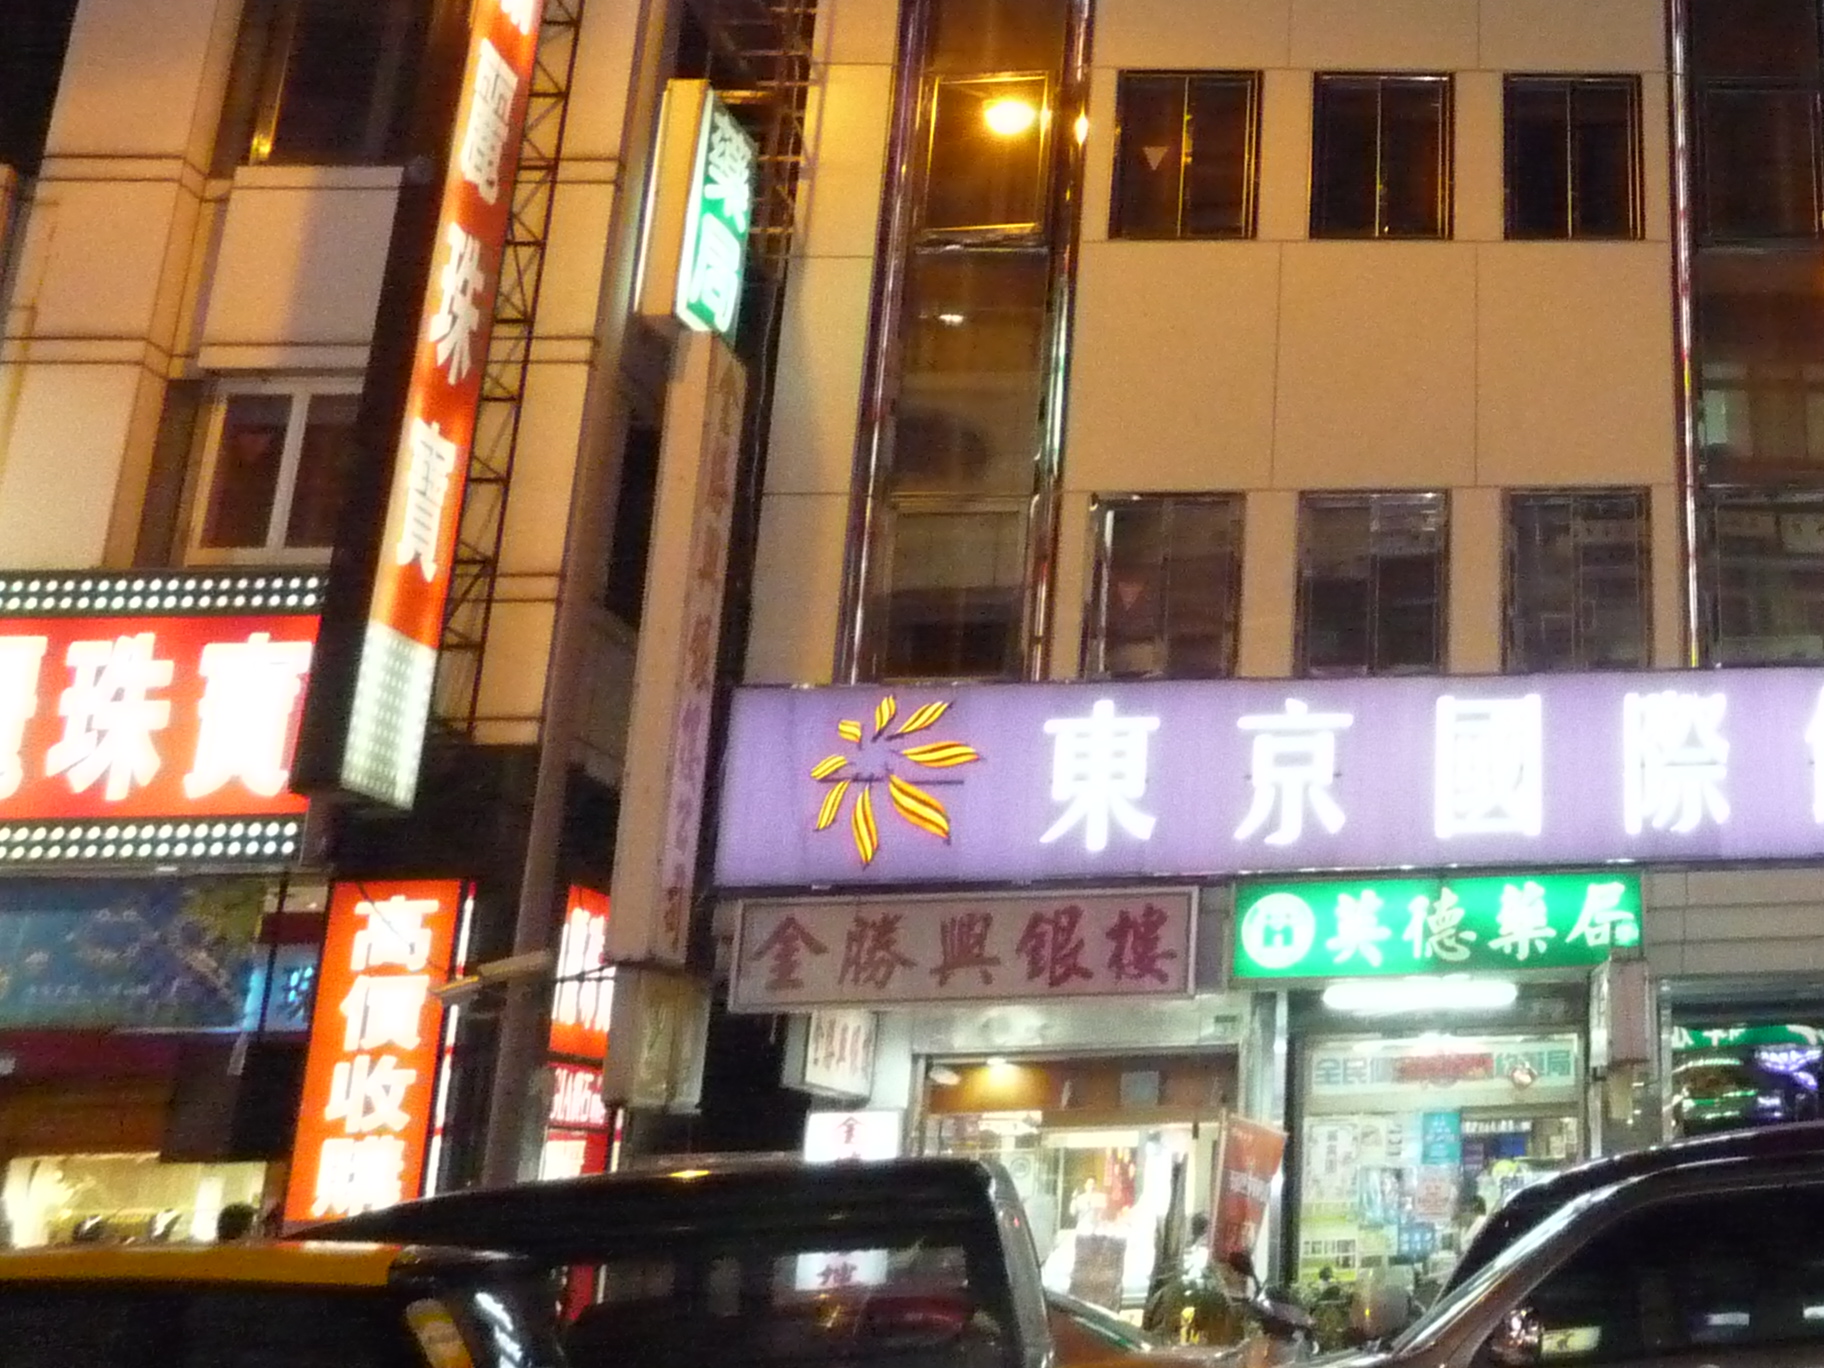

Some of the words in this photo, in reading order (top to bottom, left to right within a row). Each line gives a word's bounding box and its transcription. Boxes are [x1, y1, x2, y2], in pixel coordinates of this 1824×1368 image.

[753, 900, 1178, 992] 金勝興銀樓
[311, 895, 440, 1218] 高價收購
